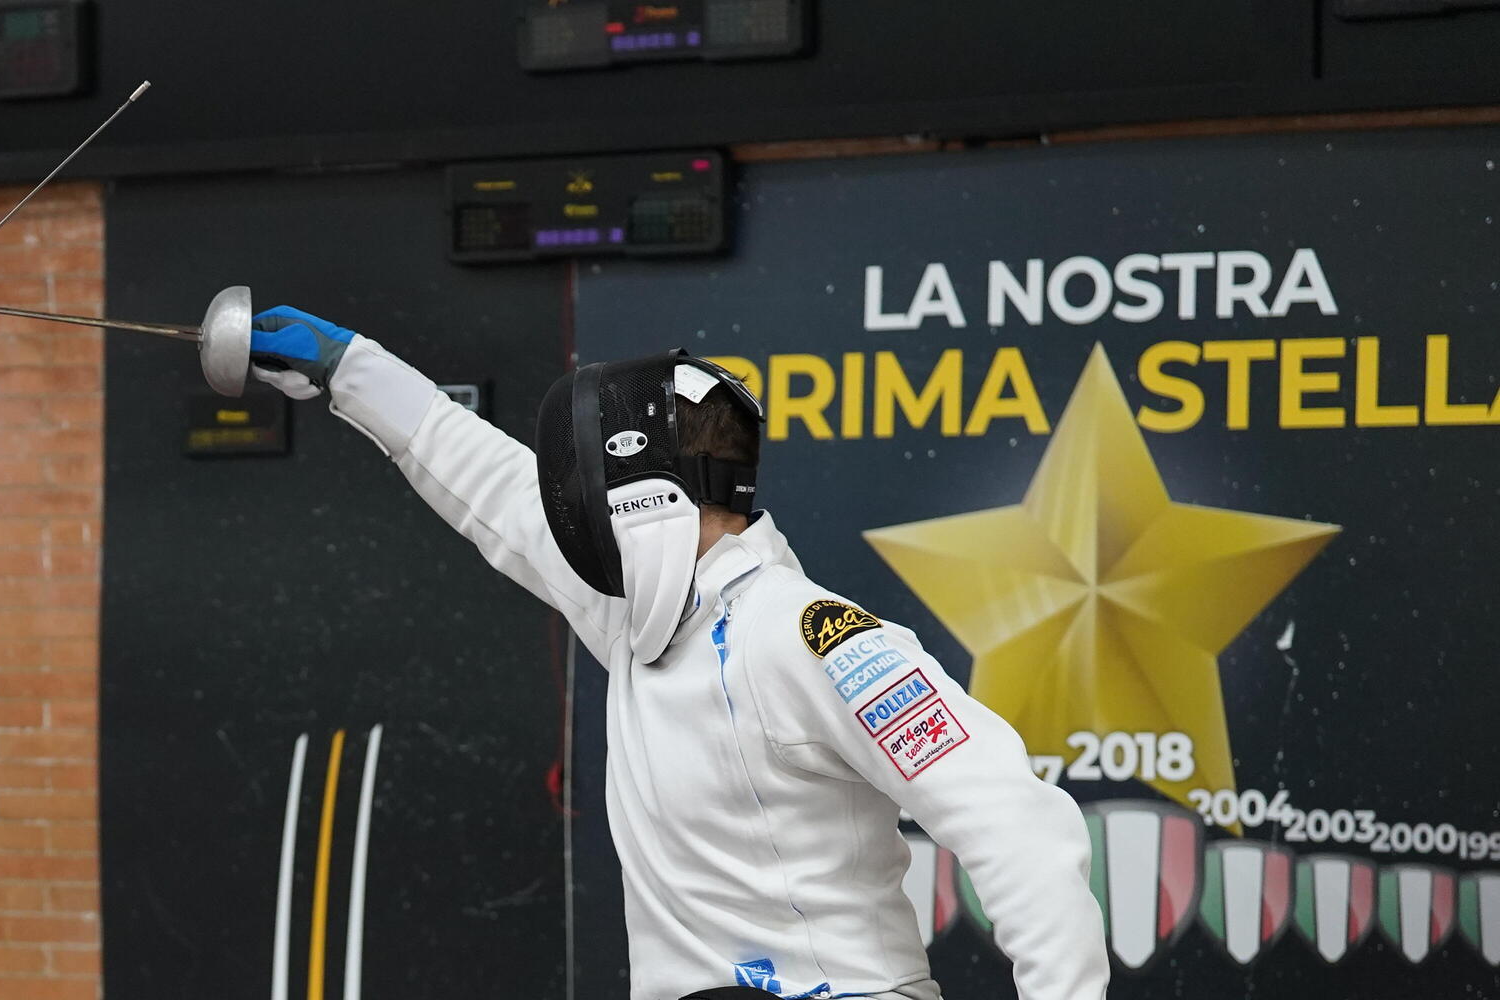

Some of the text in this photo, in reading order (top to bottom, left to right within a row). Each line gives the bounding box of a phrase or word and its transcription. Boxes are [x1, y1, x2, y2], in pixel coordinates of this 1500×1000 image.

[864, 248, 1339, 331] LA NOSTRA
[1136, 334, 1500, 434] STELL
[615, 494, 665, 515] FENC'IT
[803, 609, 816, 641] SERVIZI
[825, 634, 888, 681] FENC'IT
[864, 678, 929, 729] POLIZIA
[890, 708, 947, 755] art4sport
[905, 736, 928, 760] team
[1066, 732, 1195, 781] 2018
[1188, 789, 1295, 827] 2004
[1284, 810, 1377, 842] 2003
[1371, 823, 1458, 852] 2000
